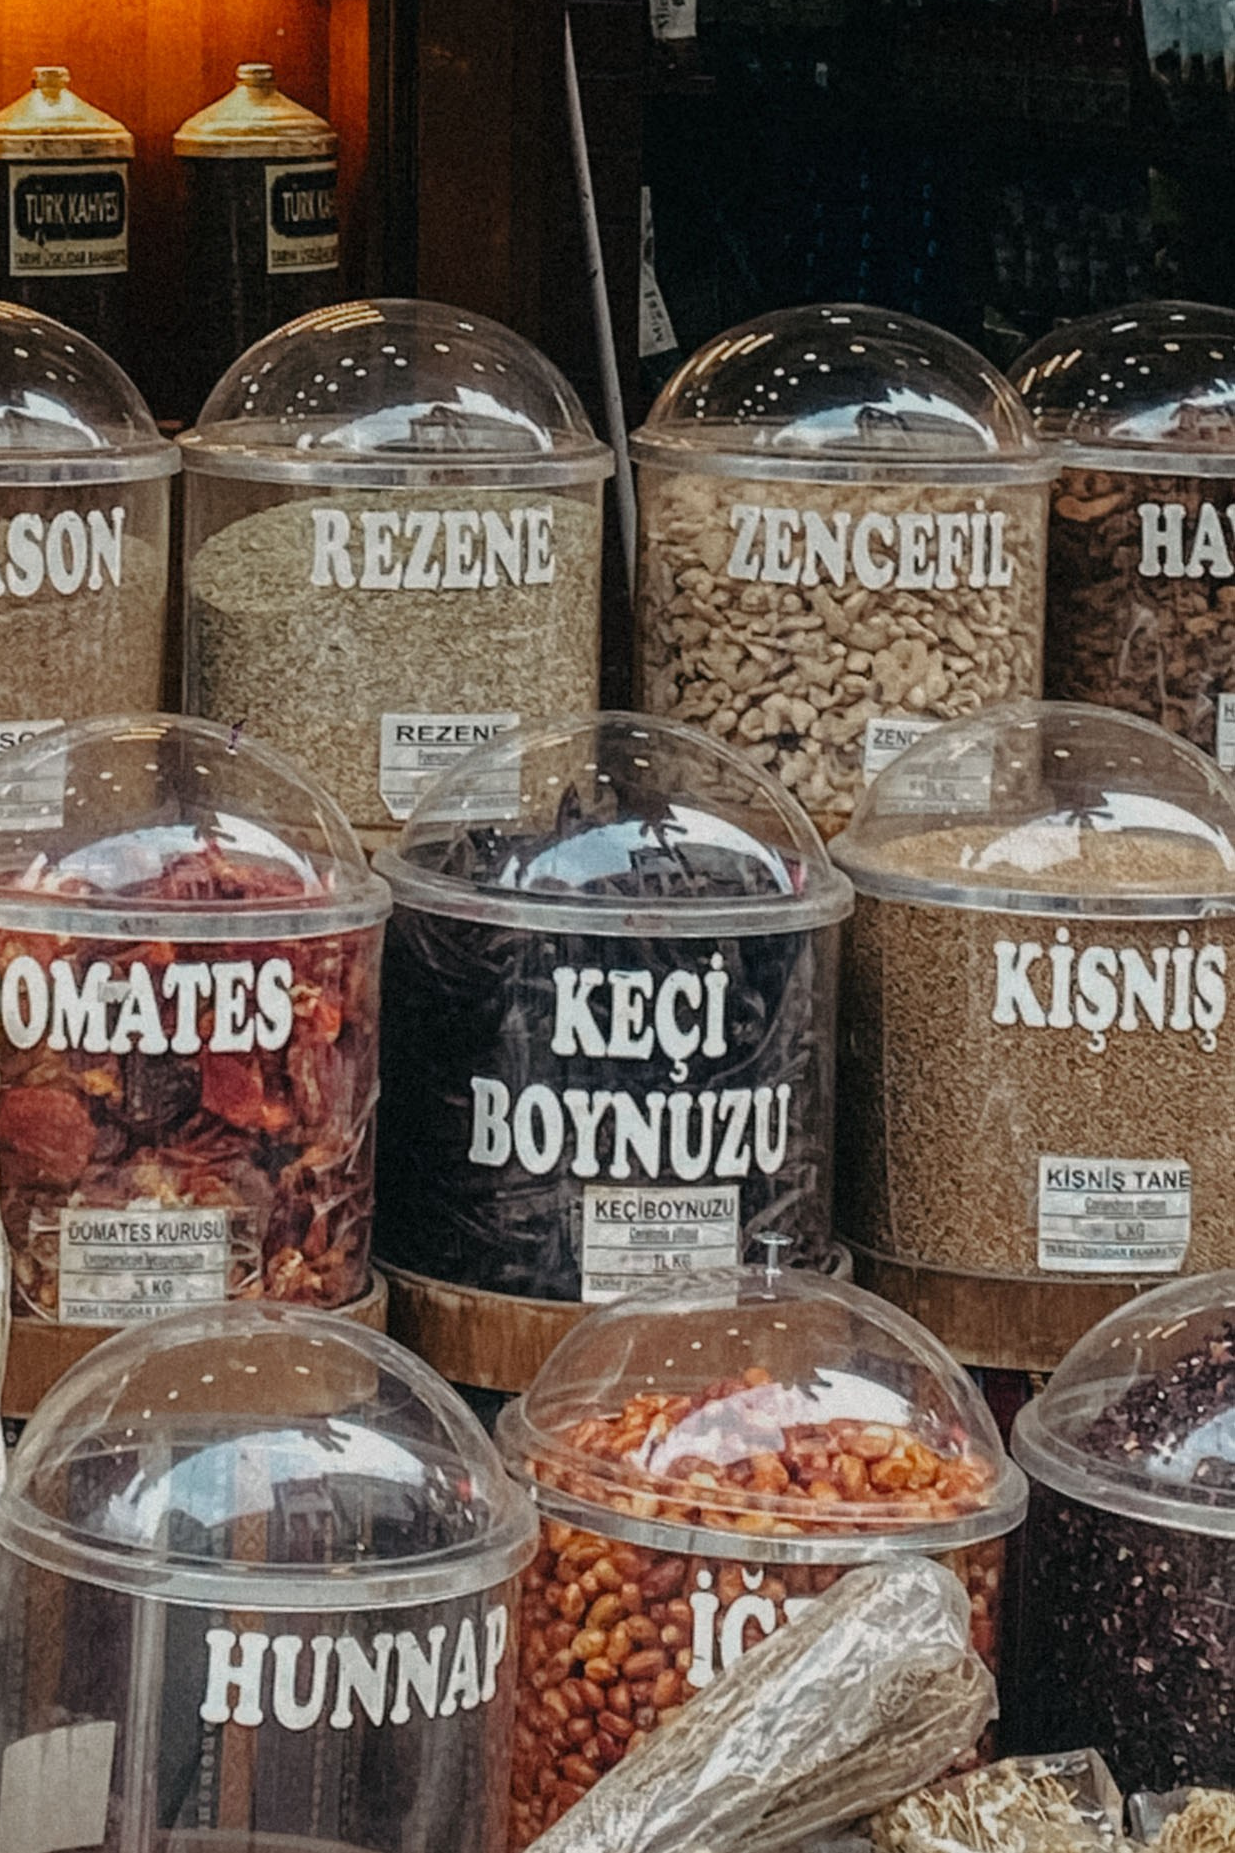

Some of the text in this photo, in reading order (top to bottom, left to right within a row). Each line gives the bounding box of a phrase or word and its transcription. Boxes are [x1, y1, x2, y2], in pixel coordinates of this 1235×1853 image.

[25, 184, 64, 224] TÜRK
[310, 505, 556, 591] REZENE
[727, 497, 1013, 591] ZENCEFİL
[551, 951, 730, 1084] KEÇİ
[992, 926, 1228, 1055] KİŞNİŞ
[468, 1075, 792, 1181] BOYNUZU
[594, 1196, 735, 1222] KEÇİBOYNUZU
[1046, 1163, 1191, 1193] KİŞNİŞ TANE
[68, 1220, 225, 1242] DOMATES KURUSU
[199, 1604, 508, 1731] HUNNAP
